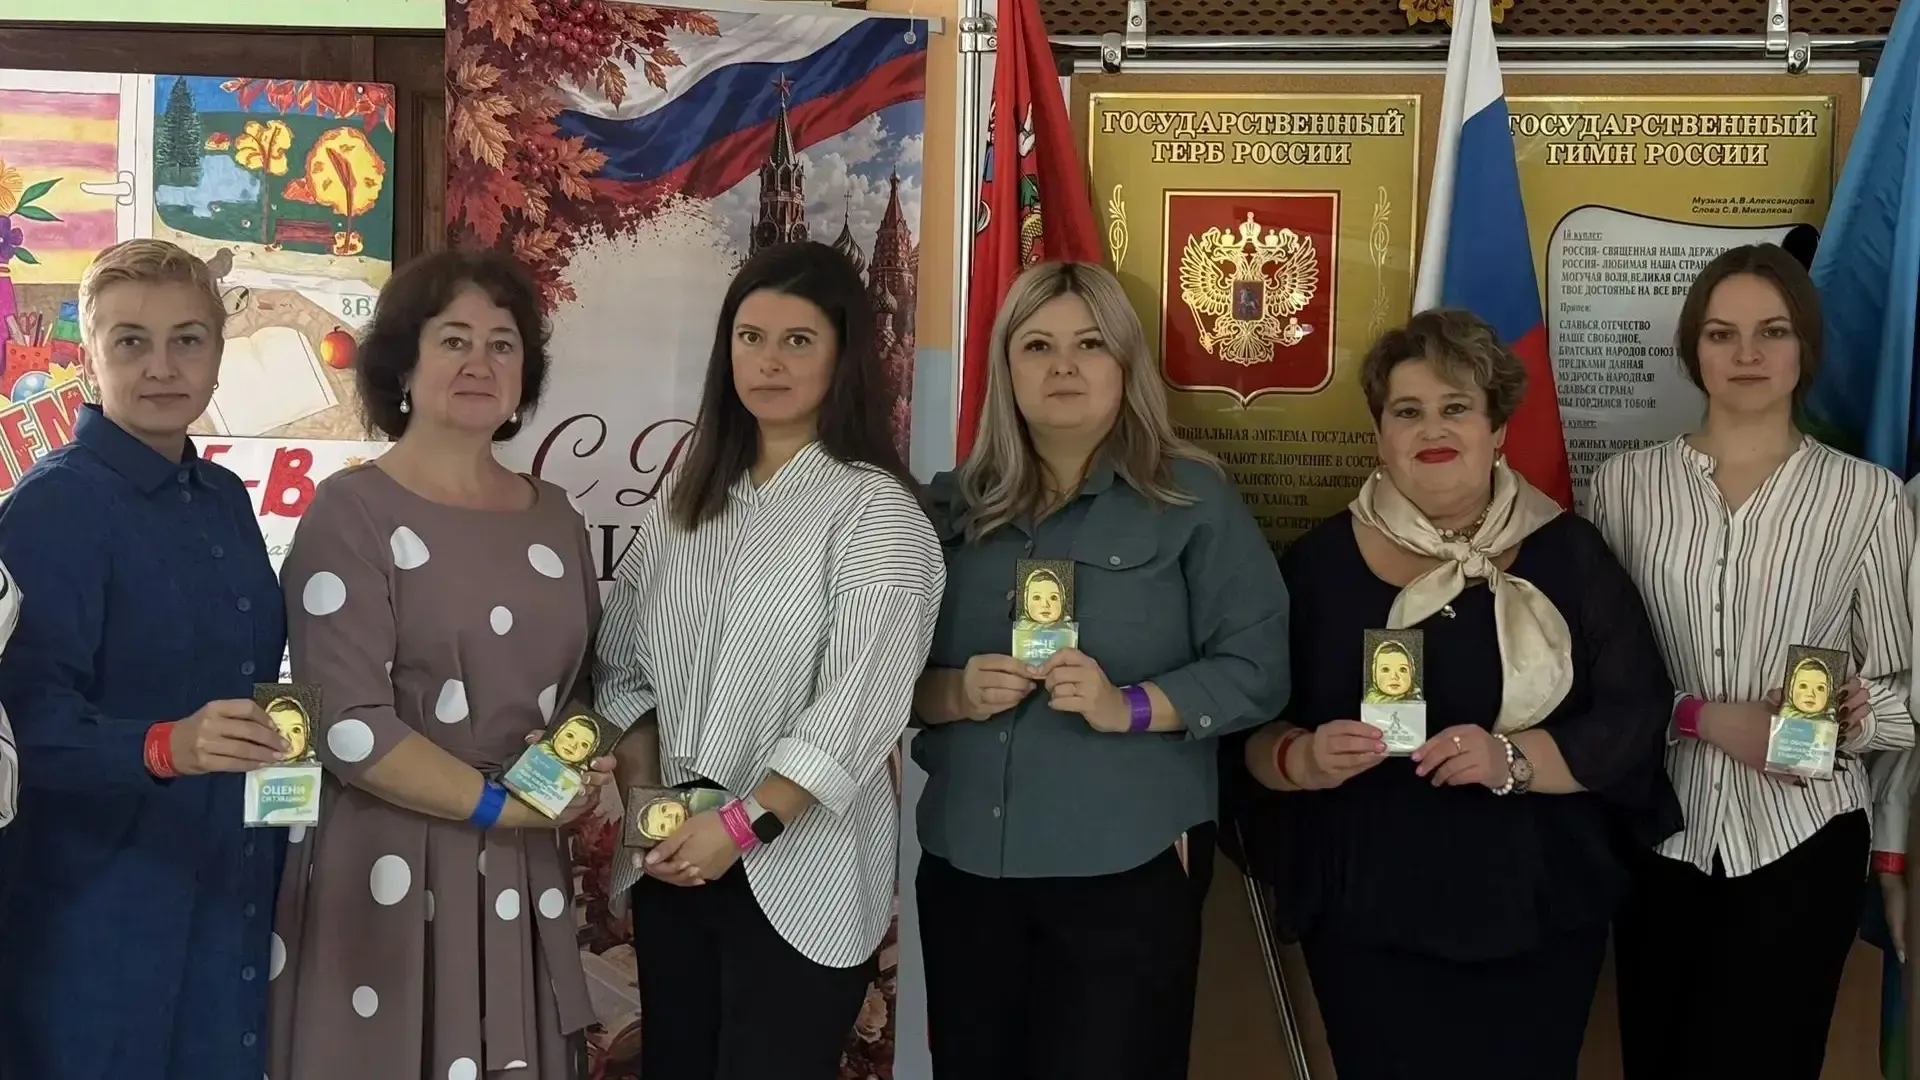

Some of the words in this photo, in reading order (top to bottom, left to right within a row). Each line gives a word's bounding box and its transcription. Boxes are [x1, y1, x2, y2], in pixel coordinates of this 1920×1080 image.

[1102, 109, 1405, 138] ГОСУДАРСТВЕННЫЙ
[1507, 110, 1817, 140] ГОСУДАРСТВЕННЫЙ
[1152, 140, 1225, 163] ГЕРБ
[1232, 142, 1351, 165] РОССИИ
[1546, 142, 1637, 165] ГИМН
[1644, 142, 1768, 166] РОССИИ
[1692, 197, 1728, 205] Музыка
[1692, 206, 1720, 214] Слова
[1602, 246, 1657, 257] СВЯЩЕННАЯ
[1659, 246, 1686, 256] НАША
[1601, 259, 1648, 269] ЛЮБИМАЯ
[1650, 260, 1676, 269] НАША
[1678, 260, 1710, 270] СТРАН
[1561, 272, 1602, 281] МОГУЧАЯ
[1562, 285, 1583, 295] ТВОЕ
[1584, 285, 1636, 296] ДОСТОЯНЬЕ
[1637, 286, 1650, 295] НА
[1653, 286, 1669, 296] ВСЕ
[1559, 333, 1585, 343] НАШЕ
[1558, 346, 1603, 356] БРАТСКИХ
[1605, 347, 1646, 358] НАРОДОВ
[1648, 347, 1674, 357] СОЮЗ
[1558, 359, 1606, 370] ПРЕДКАМИ
[1608, 360, 1644, 370] ДАННАЯ
[1558, 372, 1604, 382] МУДРОСТЬ
[1606, 373, 1655, 384] НАРОДНАЯ!
[1557, 385, 1596, 395] СЛАВЬСЯ
[1575, 398, 1622, 409] ГОРДИМСЯ
[1624, 397, 1656, 409] ТОБОЙ!
[1251, 428, 1308, 442] ЭМБЛЕМА
[1311, 430, 1377, 445] ГОСУДАРСТ
[1569, 439, 1607, 449] ЮЖНЫХ
[1609, 439, 1640, 450] МОРЕЙ
[1260, 453, 1333, 466] ВКЛЮЧЕНИЕ
[1336, 455, 1343, 467] В
